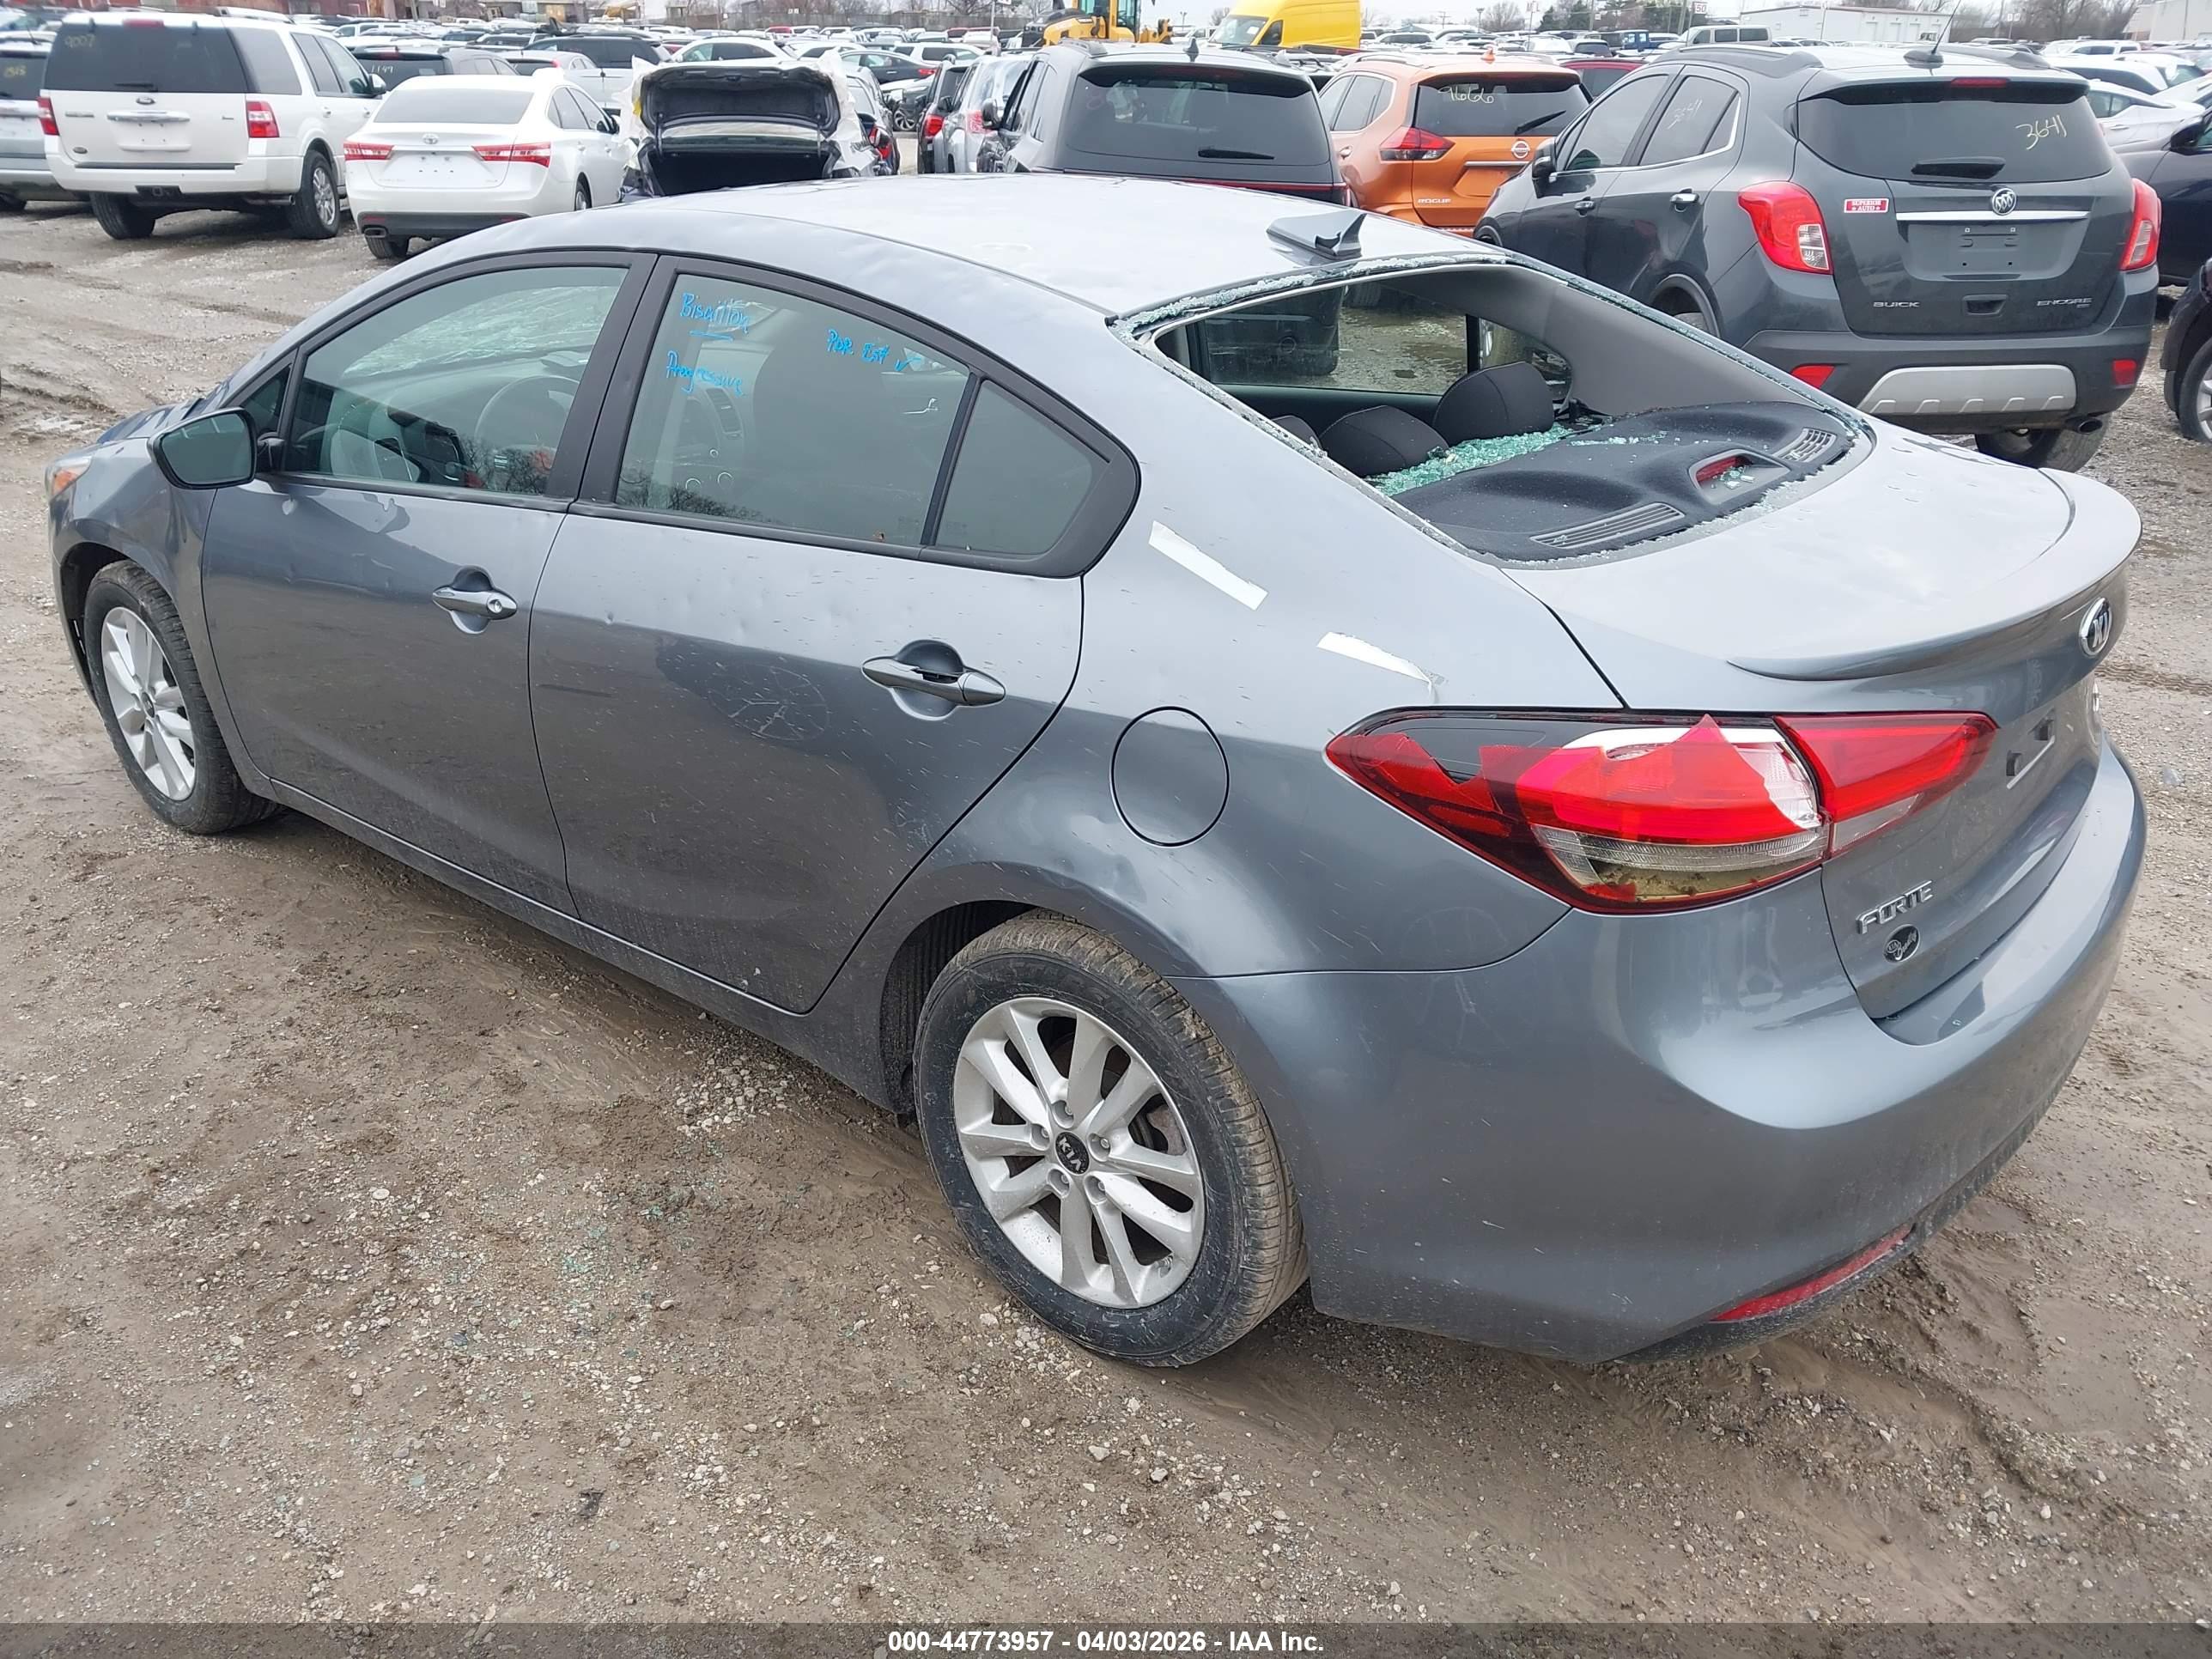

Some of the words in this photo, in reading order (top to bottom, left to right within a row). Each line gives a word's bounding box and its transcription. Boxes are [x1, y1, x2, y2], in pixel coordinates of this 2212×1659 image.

[2015, 114, 2067, 150] 3641
[2037, 297, 2093, 307] ENCORE
[1855, 880, 1933, 934] FORTE
[1059, 1136, 1082, 1172] KIA
